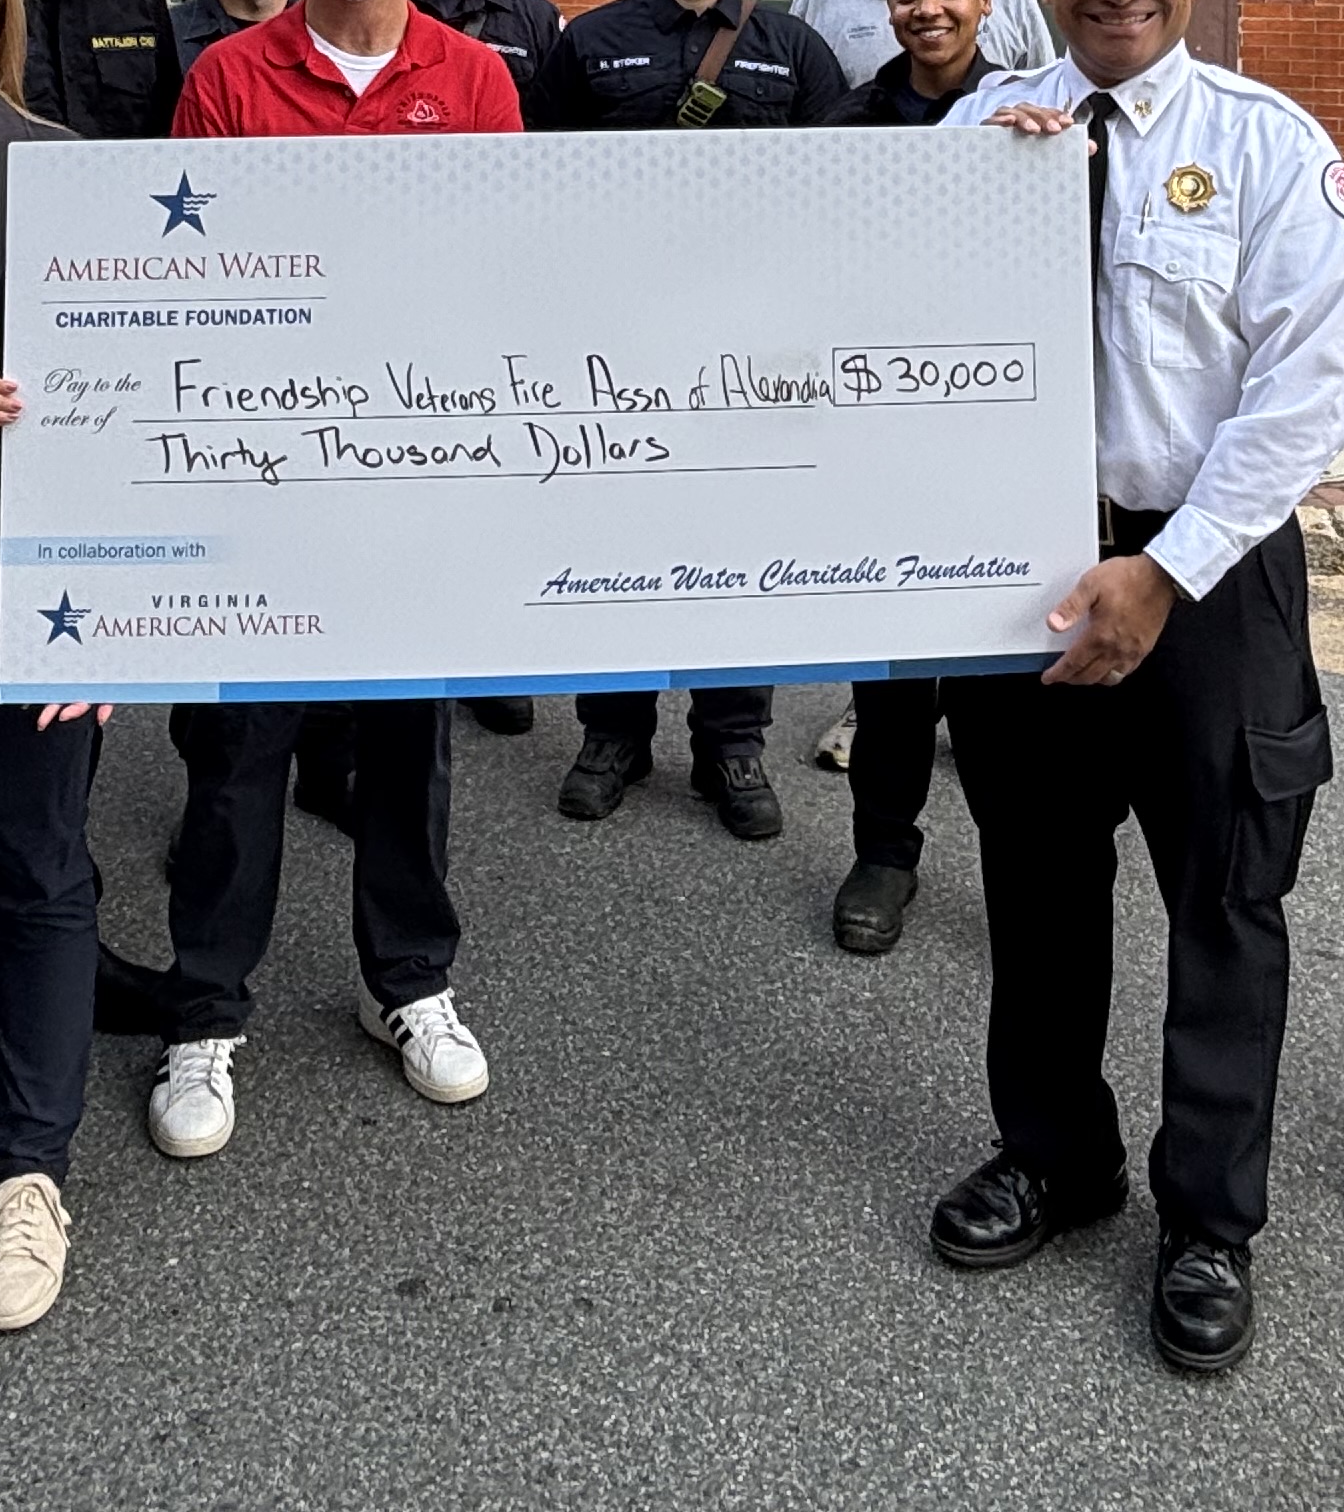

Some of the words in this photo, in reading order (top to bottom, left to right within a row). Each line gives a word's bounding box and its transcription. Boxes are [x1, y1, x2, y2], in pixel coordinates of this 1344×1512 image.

[734, 60, 790, 78] FIREFIGHTER
[44, 256, 207, 283] AMERICAN
[218, 252, 326, 279] WATER
[55, 309, 179, 329] CHARITABLE
[185, 307, 313, 327] FOUNDATION
[44, 368, 90, 403] Pay
[93, 378, 110, 392] to
[115, 373, 142, 392] the
[174, 358, 369, 418] Friendship
[586, 354, 674, 412] Assn
[688, 366, 711, 409] of
[41, 407, 90, 427] order
[93, 406, 118, 434] of
[145, 432, 288, 486] Thirty
[301, 425, 502, 468] Thousand
[523, 422, 670, 484] Dollars
[38, 543, 53, 559] In
[58, 542, 166, 559] collaboration
[172, 541, 206, 559] with
[540, 567, 663, 597] American
[669, 564, 749, 591] Water
[758, 557, 888, 592] Charitable
[895, 554, 1031, 588] Foundation
[151, 594, 269, 609] VIRGINIA
[92, 614, 228, 638] AMERICAN
[238, 611, 325, 635] WATER
